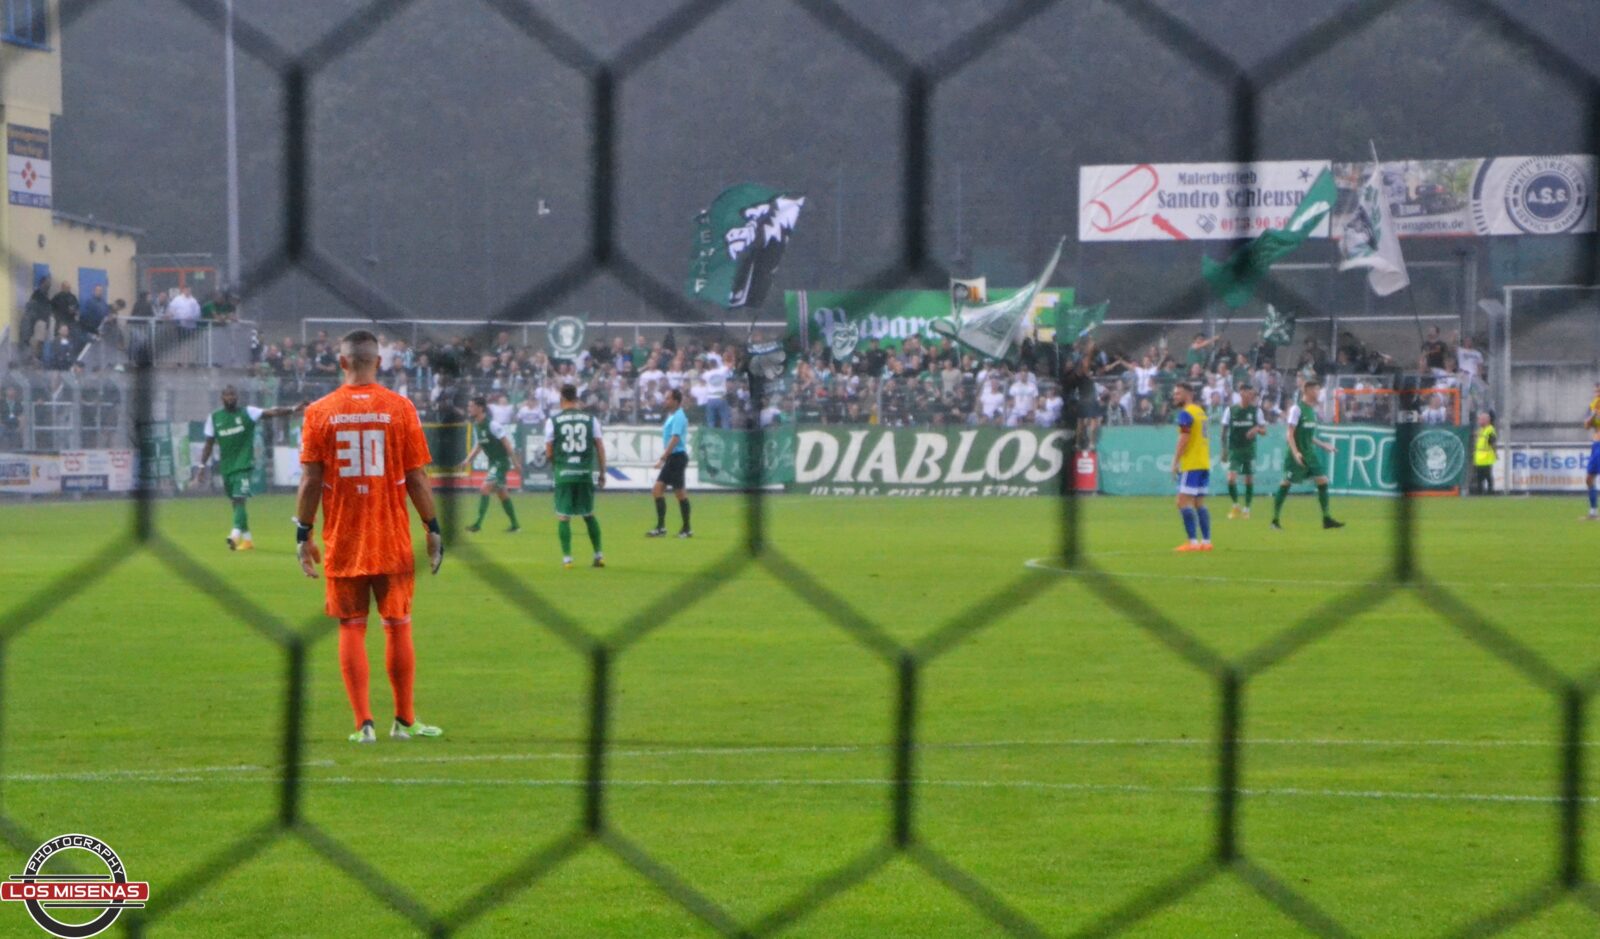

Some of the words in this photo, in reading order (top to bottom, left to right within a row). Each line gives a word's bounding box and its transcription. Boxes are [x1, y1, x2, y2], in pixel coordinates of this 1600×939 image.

[1158, 189, 1219, 208] Sandro
[336, 430, 385, 477] 30
[561, 422, 587, 453] 33
[796, 429, 1075, 485] DIABLOS
